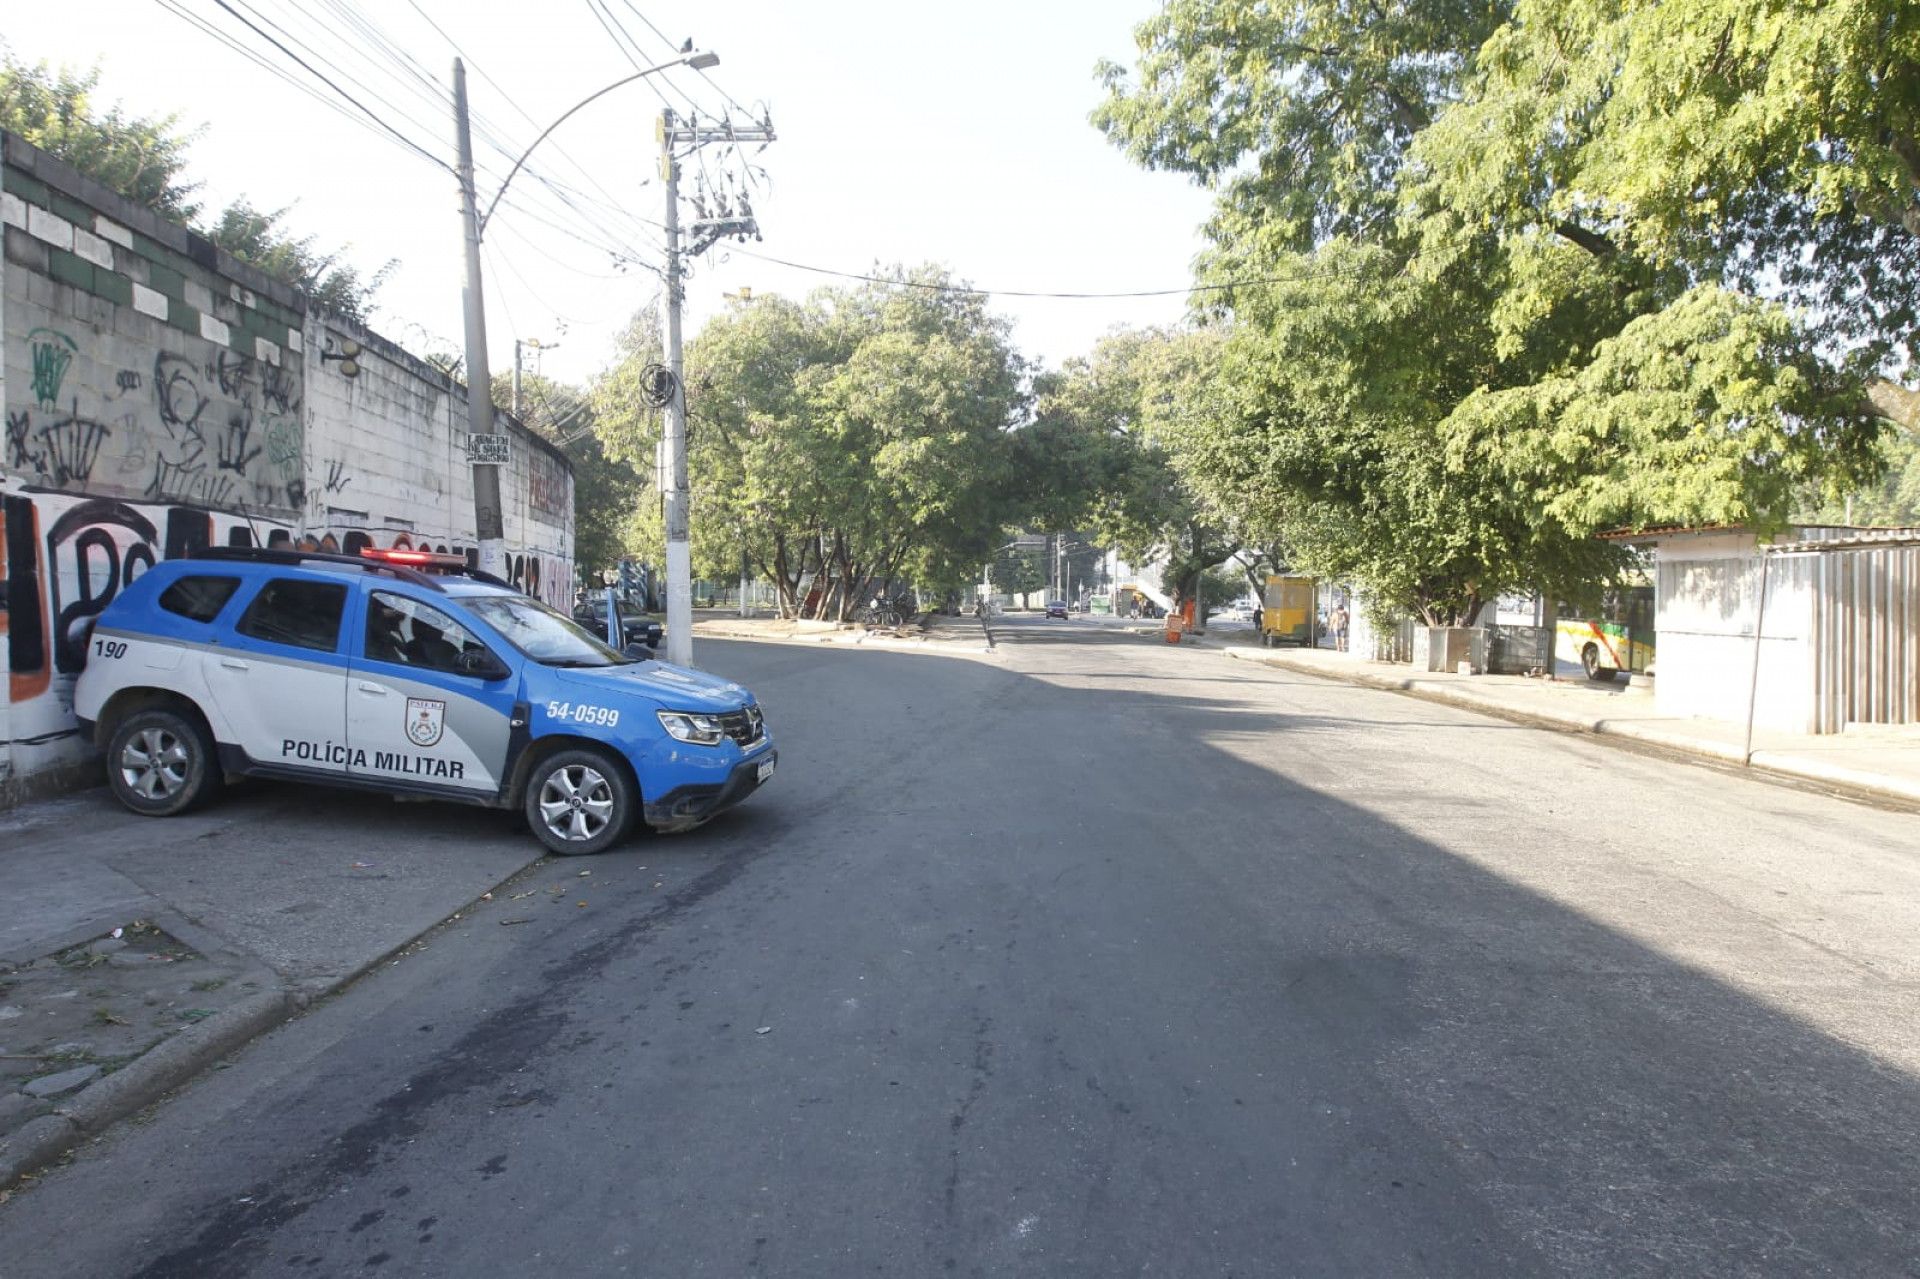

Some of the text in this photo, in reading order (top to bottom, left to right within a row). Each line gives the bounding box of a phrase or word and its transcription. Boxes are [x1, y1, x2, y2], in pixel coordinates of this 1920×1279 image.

[95, 640, 128, 660] 190
[546, 700, 619, 727] 54-0599
[282, 739, 464, 779] POLÍCIA MILITAR
